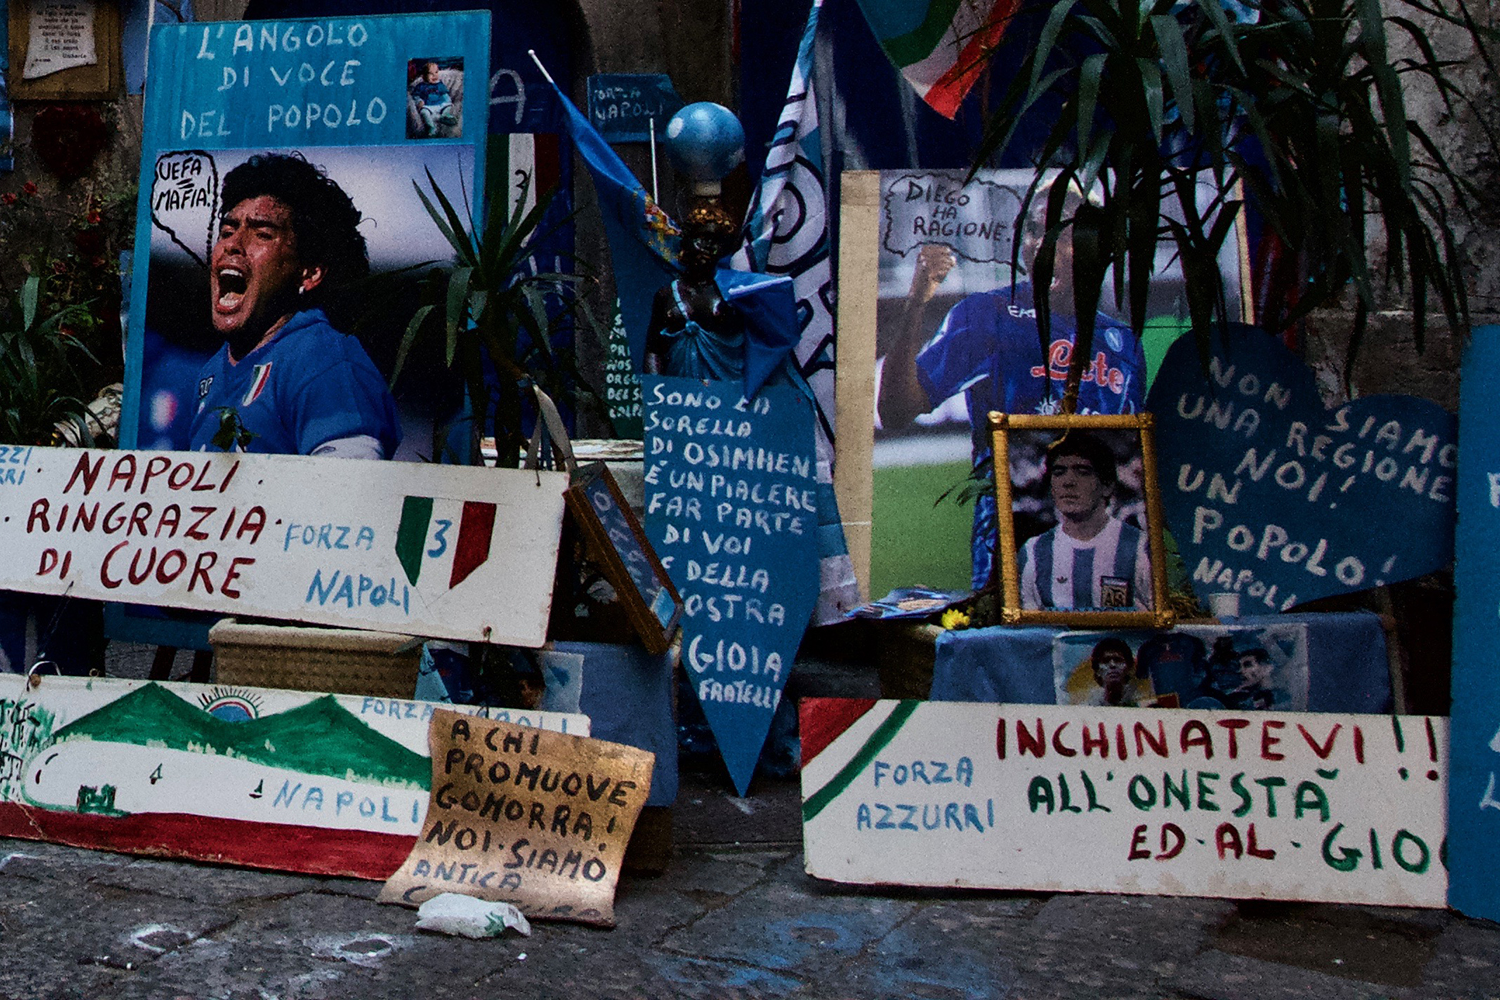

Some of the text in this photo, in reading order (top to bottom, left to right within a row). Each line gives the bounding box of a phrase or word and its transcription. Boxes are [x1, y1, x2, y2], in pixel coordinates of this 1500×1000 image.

[196, 22, 369, 61] L'ANGOLO
[217, 60, 362, 91] DI VOCE
[181, 96, 388, 140] DEL POPOLO
[159, 156, 202, 181] UEFA
[905, 180, 971, 207] DIEGO
[932, 205, 959, 220] HA
[647, 383, 721, 410] SONO
[1209, 355, 1292, 411] NON
[644, 411, 751, 437] SORELLA
[651, 437, 673, 455] DI
[1177, 392, 1261, 438] UNA
[1286, 421, 1452, 503] REGIONE
[669, 469, 704, 493] UN
[711, 475, 817, 514] PIACERE
[1177, 463, 1243, 504] UN
[648, 492, 804, 536] FAR PARTE
[283, 523, 376, 552] FORZA
[427, 519, 453, 559] 3
[662, 524, 751, 556] DI VOI
[36, 540, 257, 600] DI CUORE
[686, 559, 770, 594] DELLA
[1193, 556, 1298, 611] NAPOLI
[304, 568, 411, 616] NAPOLI
[688, 634, 783, 683] GIOIA
[698, 677, 782, 713] FRATELLI
[451, 718, 541, 756] A CHI
[444, 748, 637, 807] PROMUOVE
[872, 756, 974, 788] FORZA
[272, 779, 420, 825] NAPOLI
[855, 799, 995, 834] AZZURRI
[503, 837, 607, 883] SIAMO
[1321, 822, 1450, 874] GIO
[412, 858, 523, 893] ANTICA
